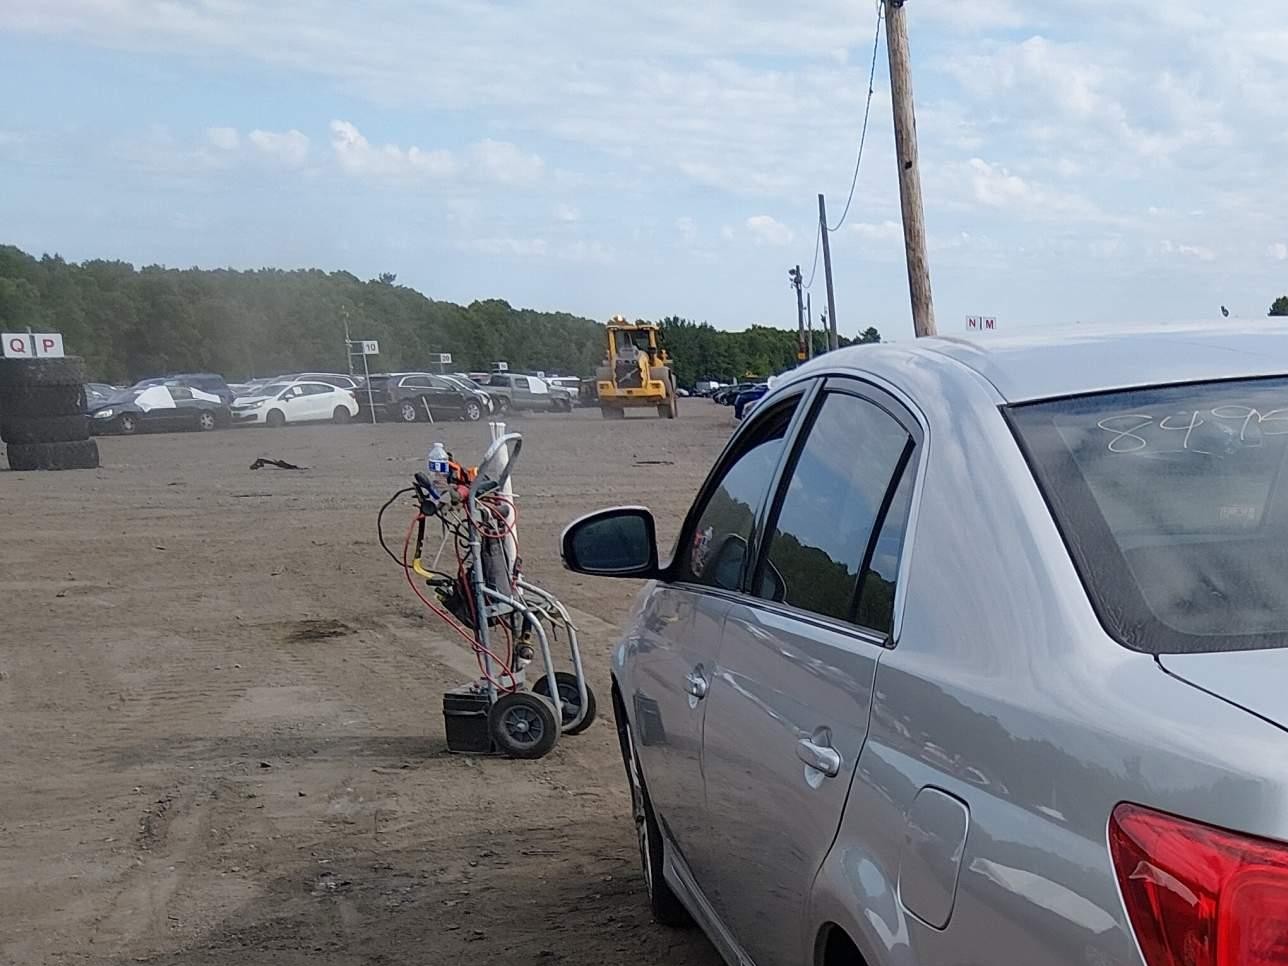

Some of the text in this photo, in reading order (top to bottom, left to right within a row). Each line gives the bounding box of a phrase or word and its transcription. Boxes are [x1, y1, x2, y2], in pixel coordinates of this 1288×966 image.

[969, 318, 976, 328] N
[985, 319, 994, 329] M
[10, 338, 26, 353] Q
[42, 338, 55, 353] P
[366, 343, 376, 351] 10
